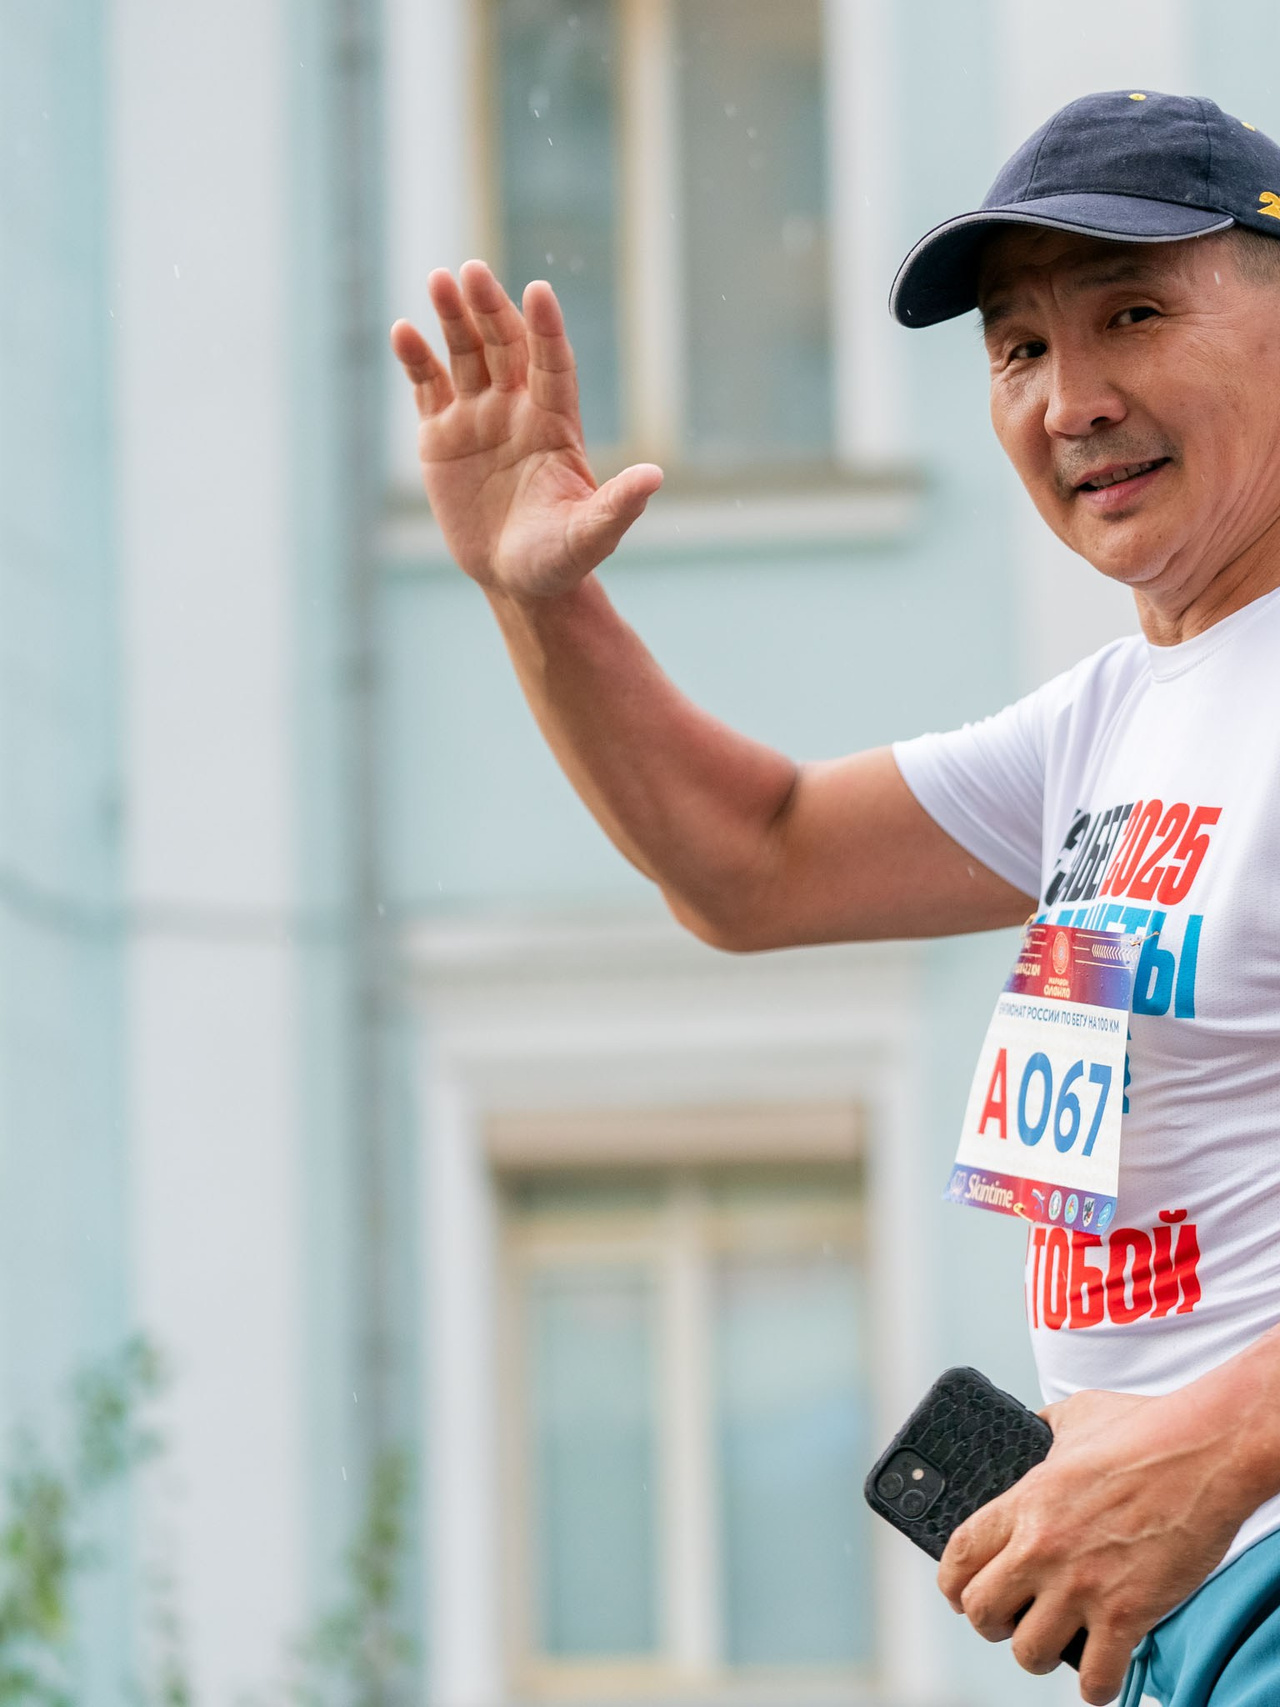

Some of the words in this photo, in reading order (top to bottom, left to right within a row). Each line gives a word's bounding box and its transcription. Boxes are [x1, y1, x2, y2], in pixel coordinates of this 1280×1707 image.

[1027, 1006, 1060, 1023] РОССИИ
[1061, 1011, 1071, 1026] ПО
[1072, 1013, 1088, 1028] БЕГУ
[1109, 1019, 1120, 1033] КМ
[964, 1174, 1014, 1208] Skintime
[1033, 1208, 1202, 1331] ТОБОЙ
